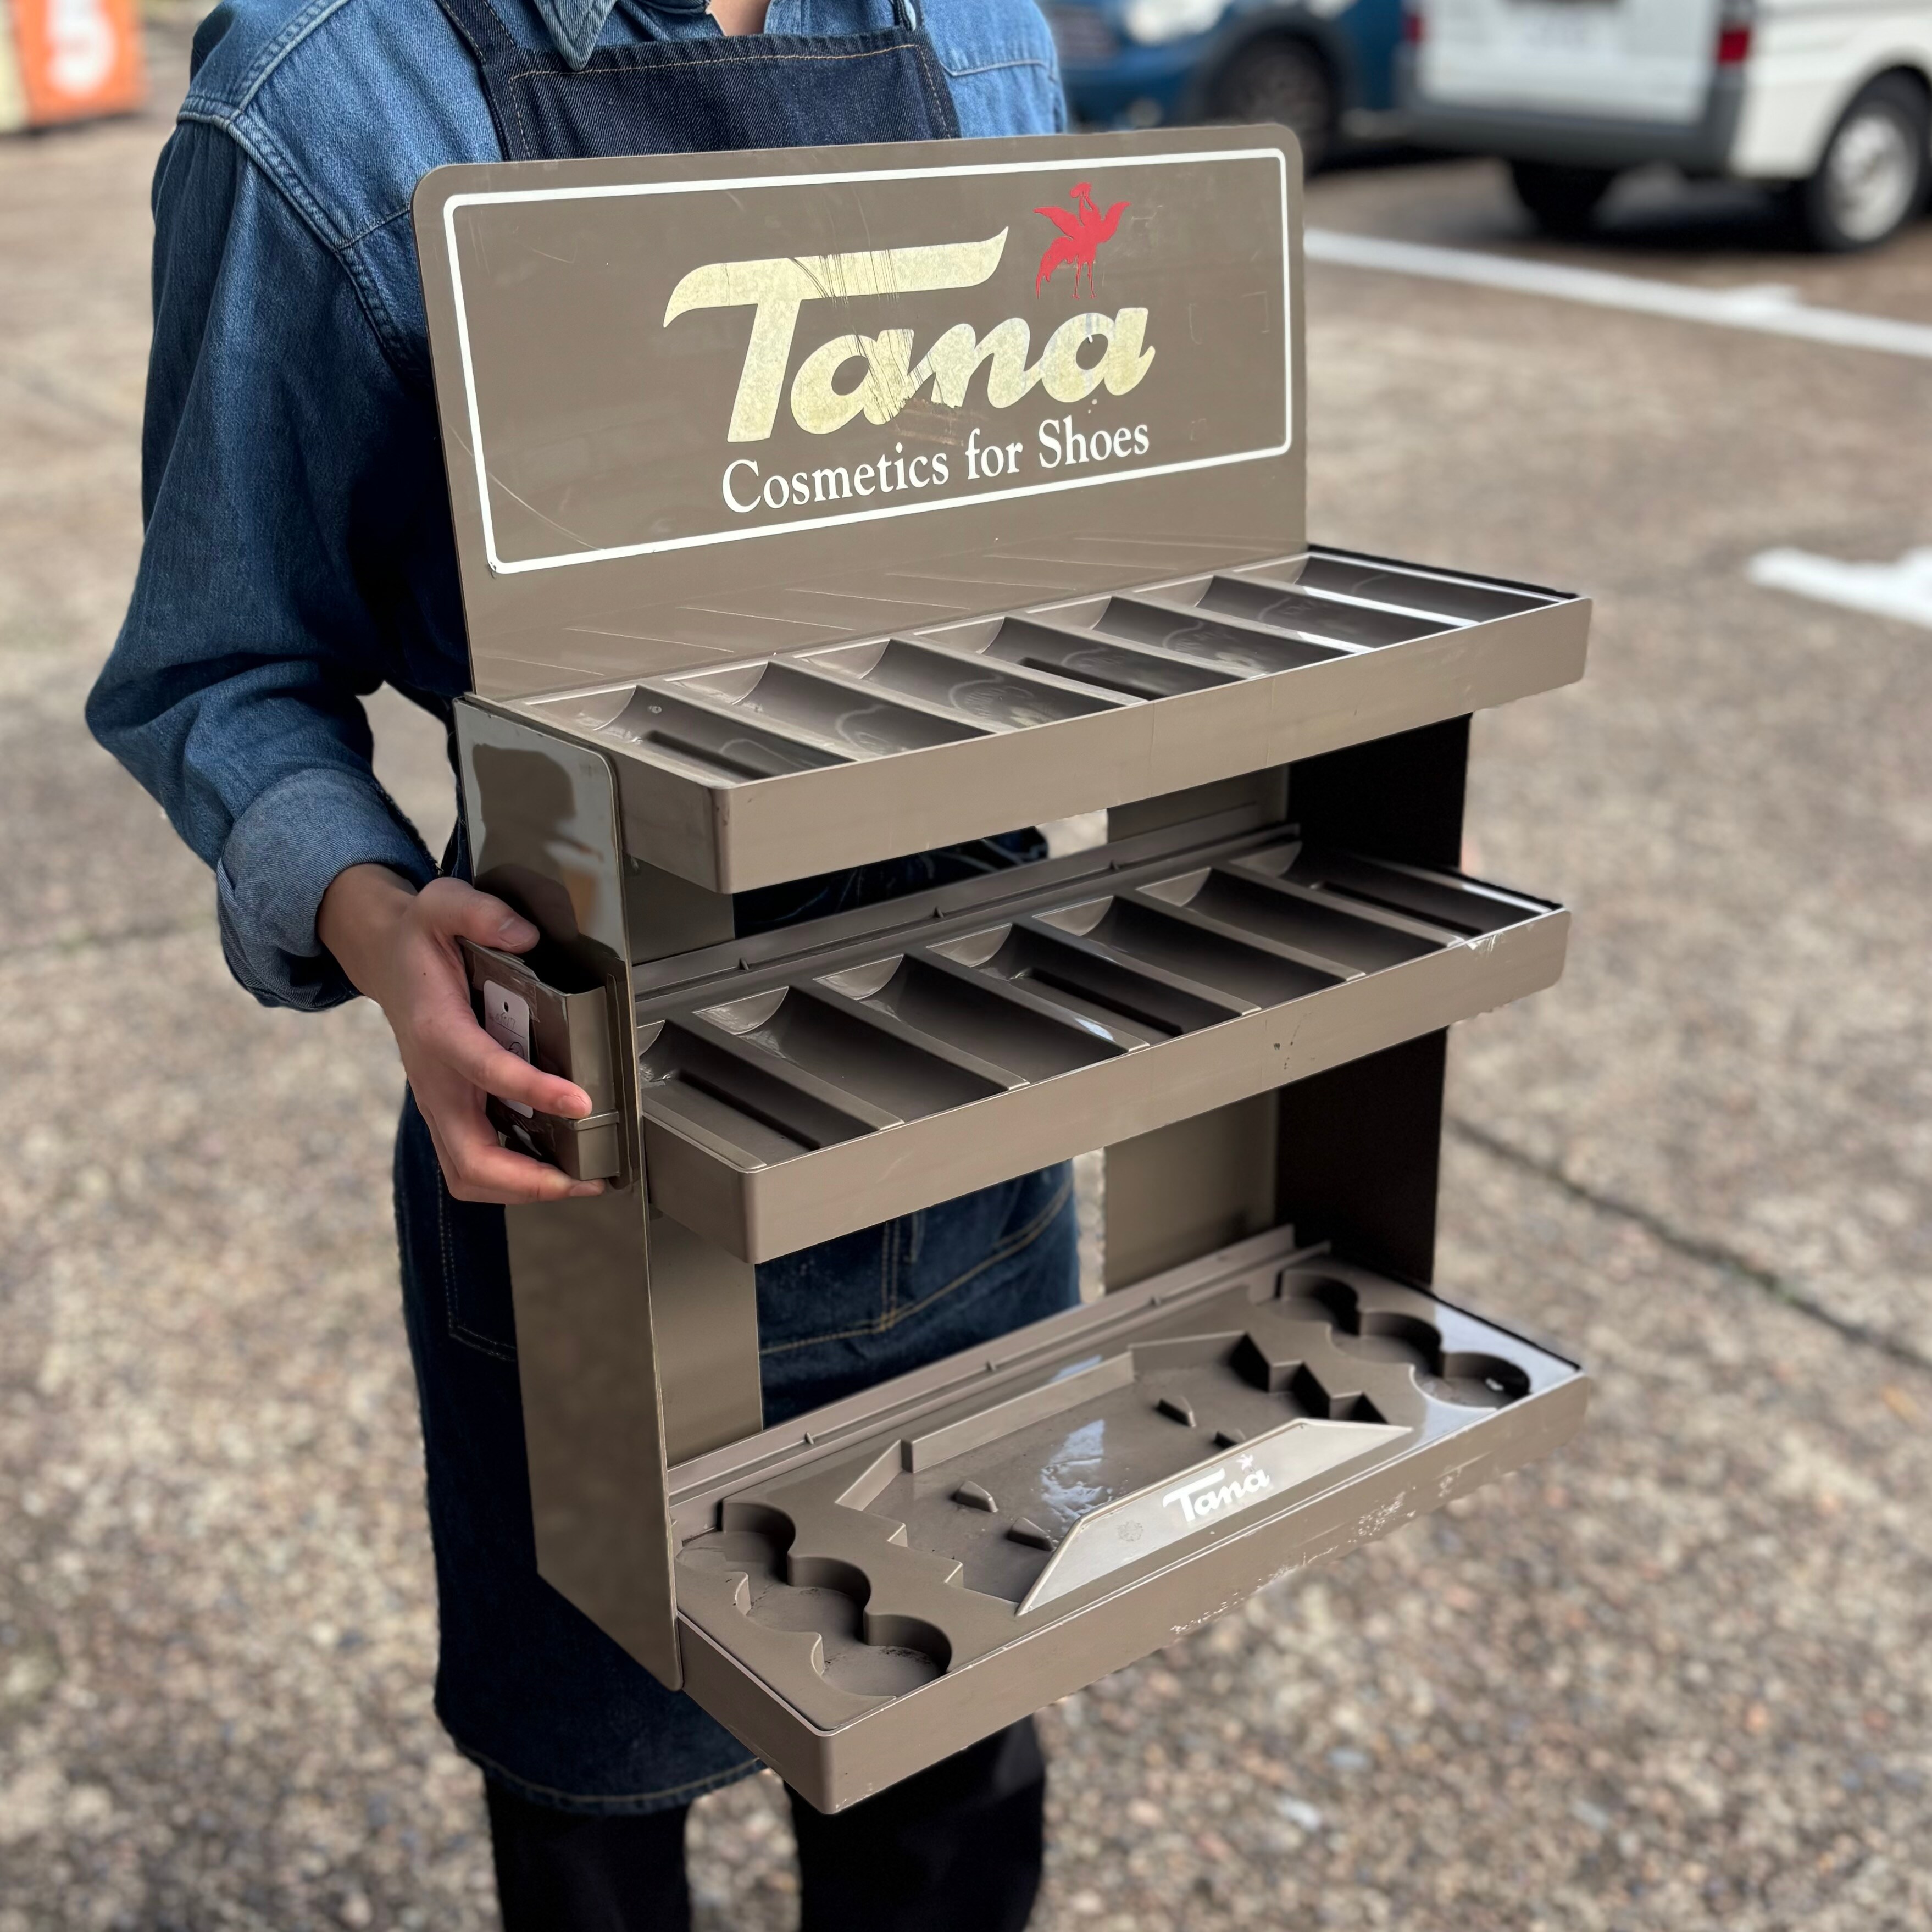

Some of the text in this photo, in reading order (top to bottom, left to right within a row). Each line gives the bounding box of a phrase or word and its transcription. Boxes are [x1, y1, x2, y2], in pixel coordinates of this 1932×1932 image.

[663, 226, 1156, 443] Tana
[722, 419, 1150, 513] Cosmetics for Shoes
[1162, 1468, 1270, 1522] Tana
